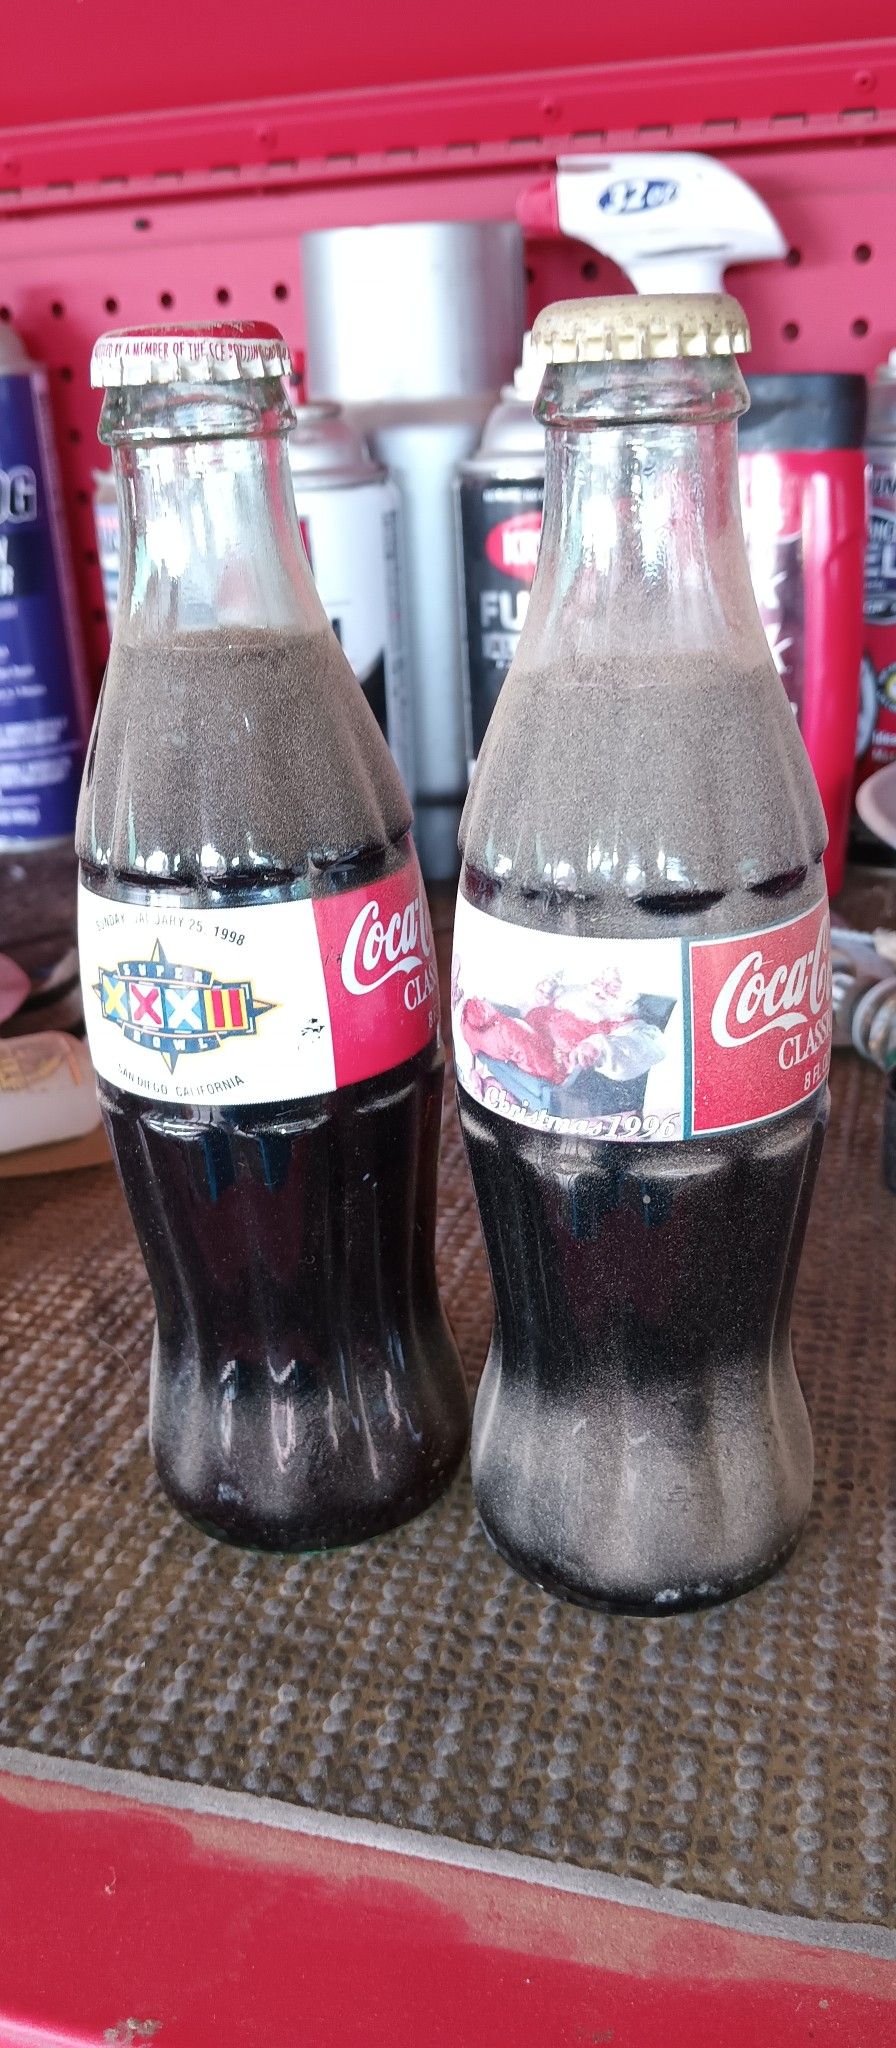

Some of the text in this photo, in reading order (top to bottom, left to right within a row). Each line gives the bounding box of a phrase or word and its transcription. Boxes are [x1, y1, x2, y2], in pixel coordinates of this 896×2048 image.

[125, 342, 130, 355] A
[133, 342, 168, 359] MEMBER
[173, 342, 184, 357] OF
[188, 342, 205, 361] THE
[214, 926, 246, 946] 1998
[122, 963, 203, 983] SUPER
[132, 1030, 209, 1051] BOWL
[803, 1070, 811, 1091] 8
[484, 1086, 680, 1138] Christmas 1996
